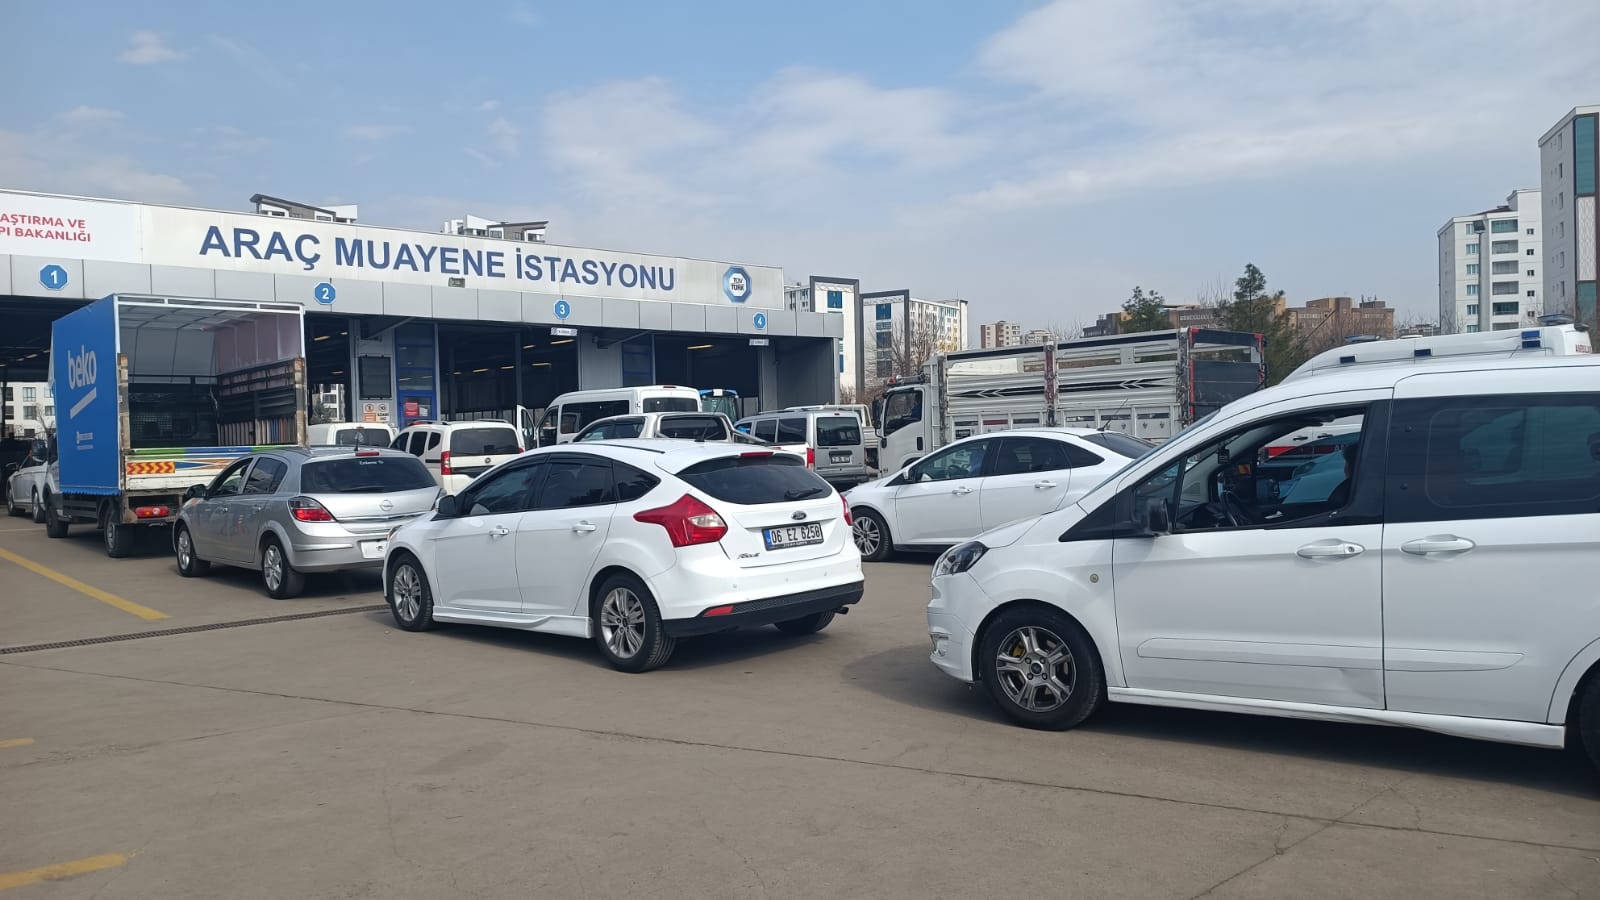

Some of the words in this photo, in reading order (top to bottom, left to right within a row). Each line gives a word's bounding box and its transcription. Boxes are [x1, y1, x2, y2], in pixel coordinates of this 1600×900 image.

[67, 218, 86, 229] VE
[15, 227, 91, 242] BAKANLIĞI
[199, 225, 321, 271] ARAÇ
[335, 237, 506, 278] MUAYENE
[515, 247, 675, 291] İSTASYONU
[50, 270, 59, 285] 1
[322, 287, 330, 300] 2
[559, 304, 566, 315] 3
[67, 344, 97, 390] beko
[771, 530, 782, 543] 06
[786, 528, 798, 541] EZ
[800, 525, 820, 540] 6258
